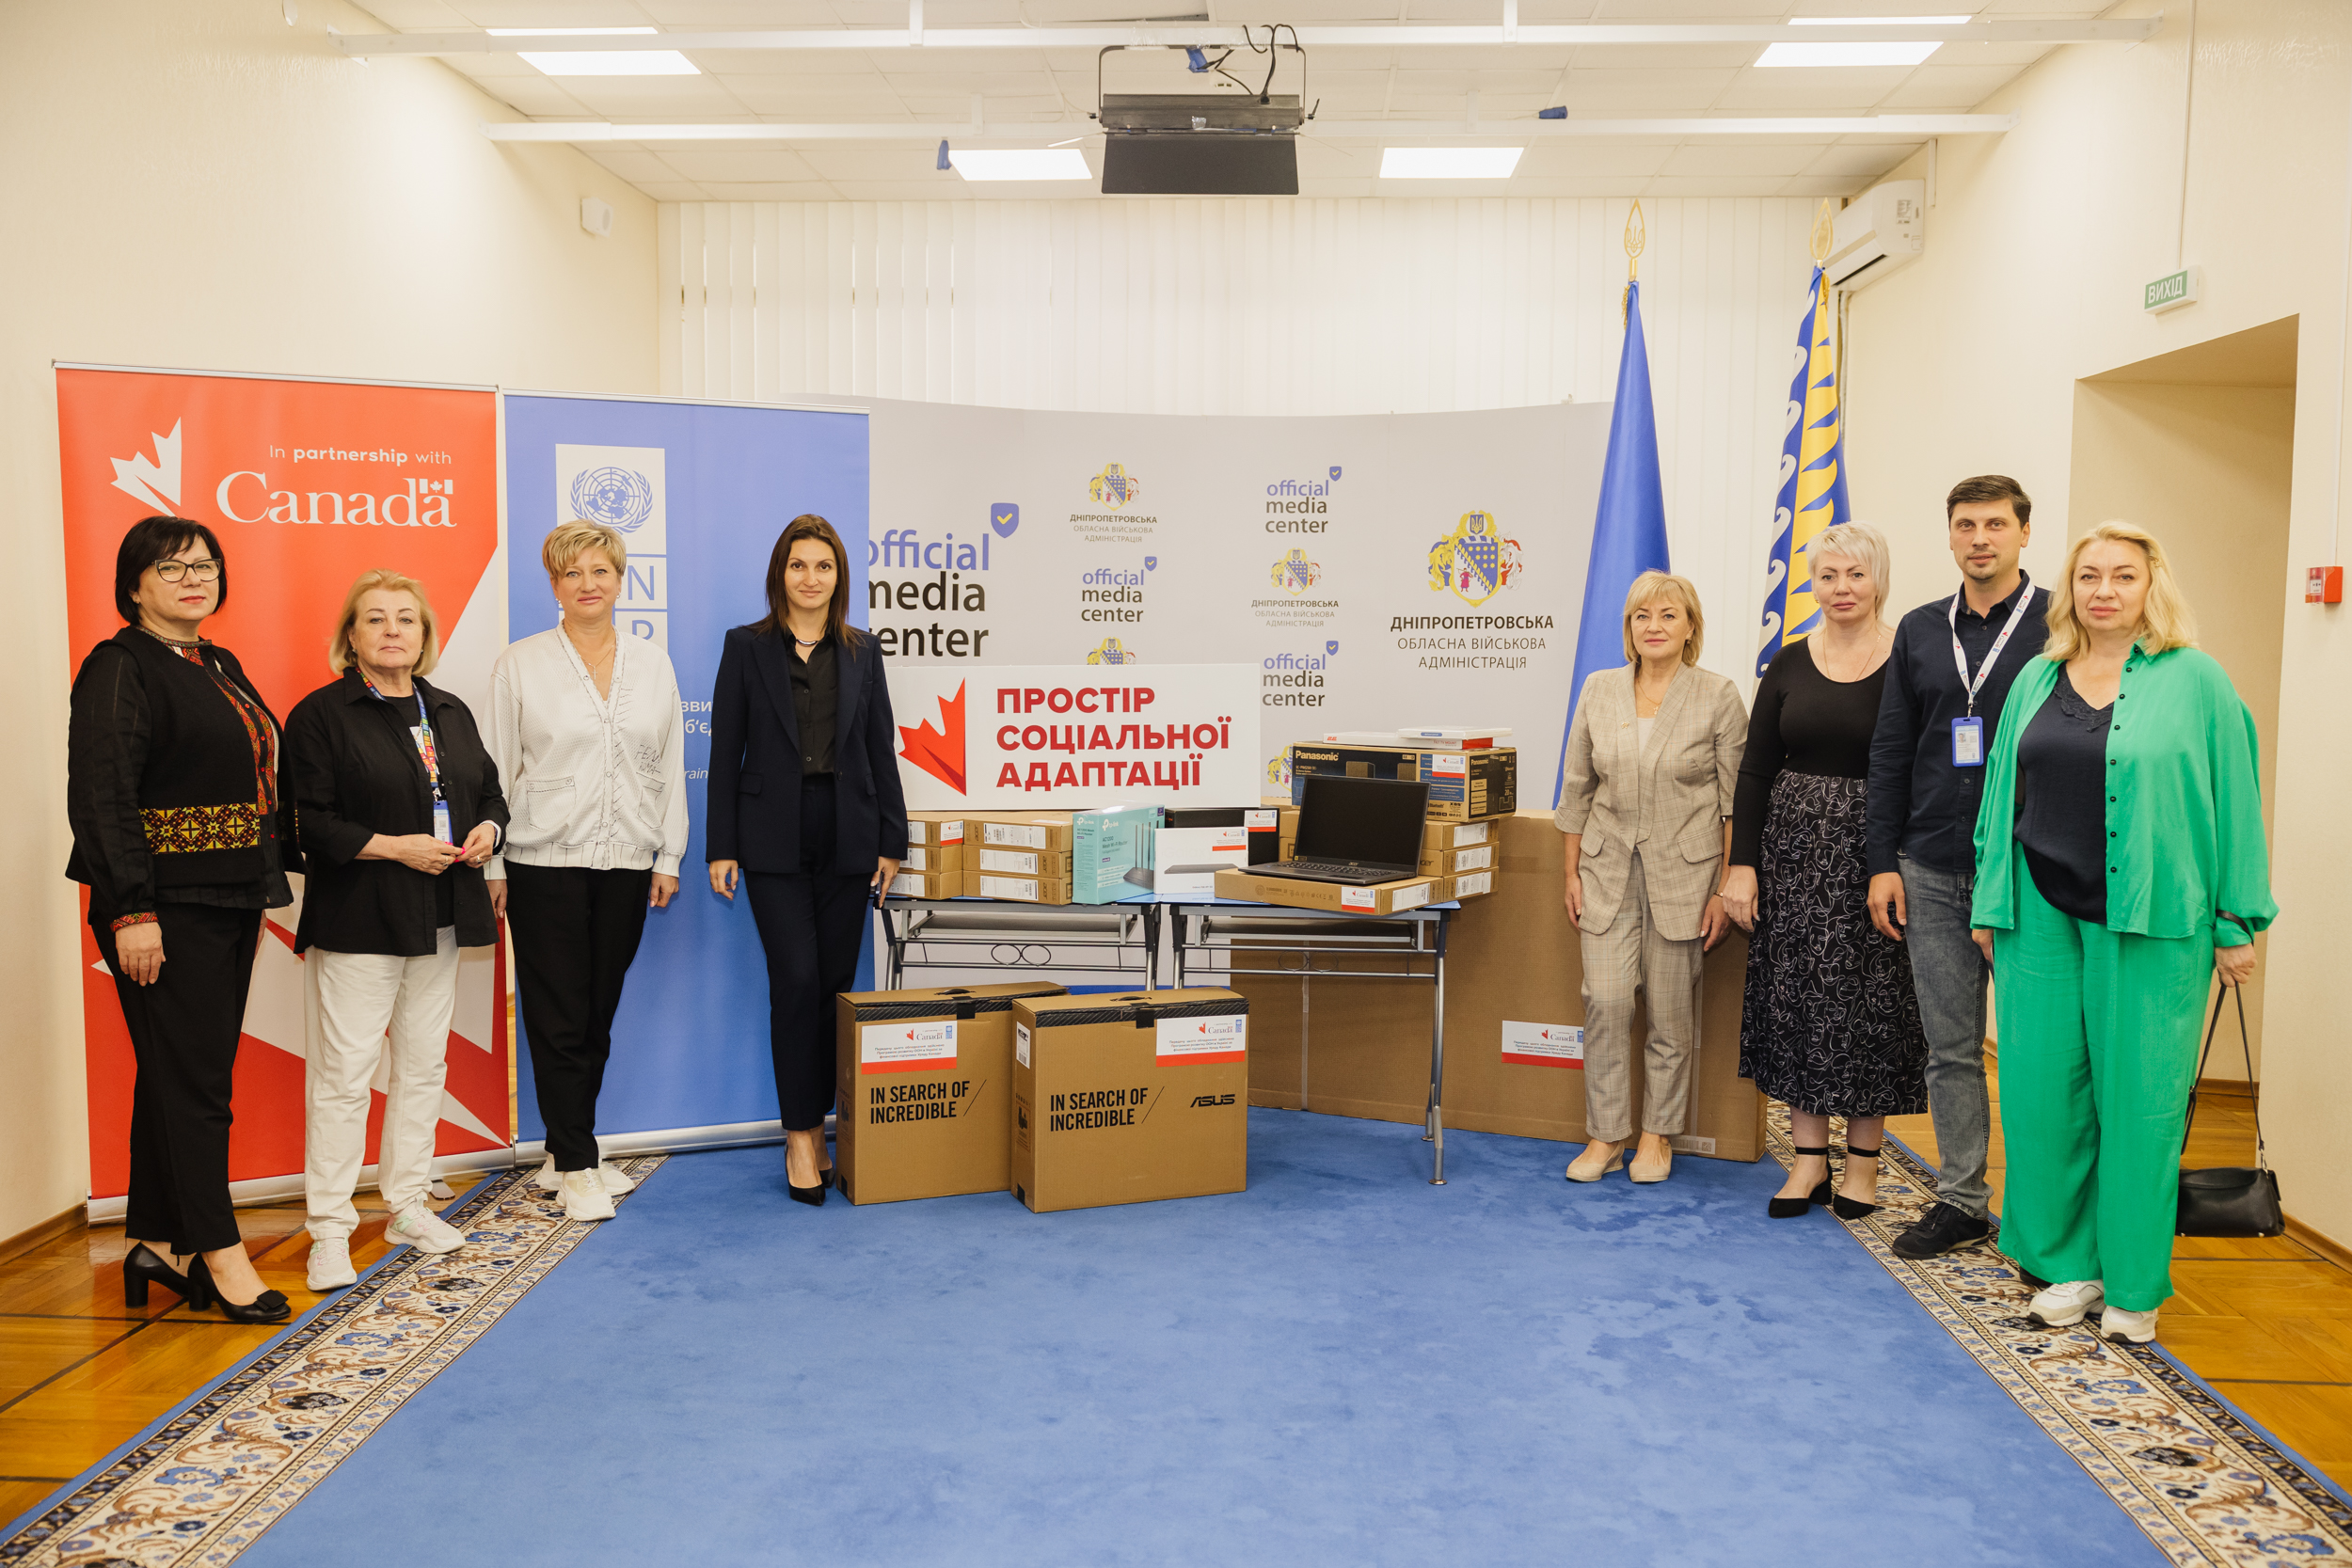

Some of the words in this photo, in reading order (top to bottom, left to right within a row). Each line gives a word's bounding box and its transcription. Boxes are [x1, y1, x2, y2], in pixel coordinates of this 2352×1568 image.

[2148, 275, 2183, 305] ВИХІД
[269, 445, 286, 459] In
[293, 446, 408, 467] partnership
[415, 451, 453, 465] with
[1266, 480, 1329, 497] official
[215, 470, 457, 528] Canada
[1265, 497, 1327, 514] media
[1069, 514, 1158, 525] ДНІПРОПЕТРОВСЬКА
[1264, 518, 1328, 533] center
[1073, 525, 1106, 533] ОБЛАСНА
[1108, 525, 1153, 534] ВІЙСЬКОВА
[1084, 534, 1143, 544] АДМІНІСТРАЦІЯ
[1081, 568, 1145, 586] official
[1081, 585, 1143, 604] media
[1251, 599, 1340, 609] ДНІПРОПЕТРОВСЬКА
[1080, 607, 1144, 623] center
[1254, 610, 1292, 618] ОБЛАСНА
[1293, 610, 1335, 618] ВІЙСЬКОВА
[1265, 620, 1325, 628] АДМІНІСТРАЦІЯ
[1390, 615, 1554, 632] ДНІПРОПЕТРОВСЬКА
[868, 622, 990, 658] enter
[1397, 637, 1467, 650] ОБЛАСНА
[1470, 636, 1547, 650] ВІЙСЬКОВА
[1263, 654, 1327, 670] official
[1418, 657, 1527, 671] АДМІНІСТРАЦІЯ
[1262, 671, 1324, 688] media
[681, 701, 713, 713] зви
[996, 687, 1155, 714] ПРОСТІР
[1262, 691, 1326, 707] center
[996, 716, 1232, 754] СОЦІАЛЬНОЇ
[1295, 751, 1339, 762] Panasonic
[996, 753, 1203, 792] АДАПТАЦІЇ
[915, 1032, 943, 1041] Canada
[870, 1086, 885, 1105] IN
[890, 1083, 947, 1102] SEARCH
[951, 1081, 970, 1098] OF
[1050, 1094, 1065, 1112] IN
[1069, 1089, 1126, 1110] SEARCH
[1129, 1087, 1148, 1104] OF
[1189, 1094, 1236, 1108] ASUS
[870, 1101, 958, 1124] INCREDIBLE
[1050, 1108, 1136, 1132] INCREDIBLE
